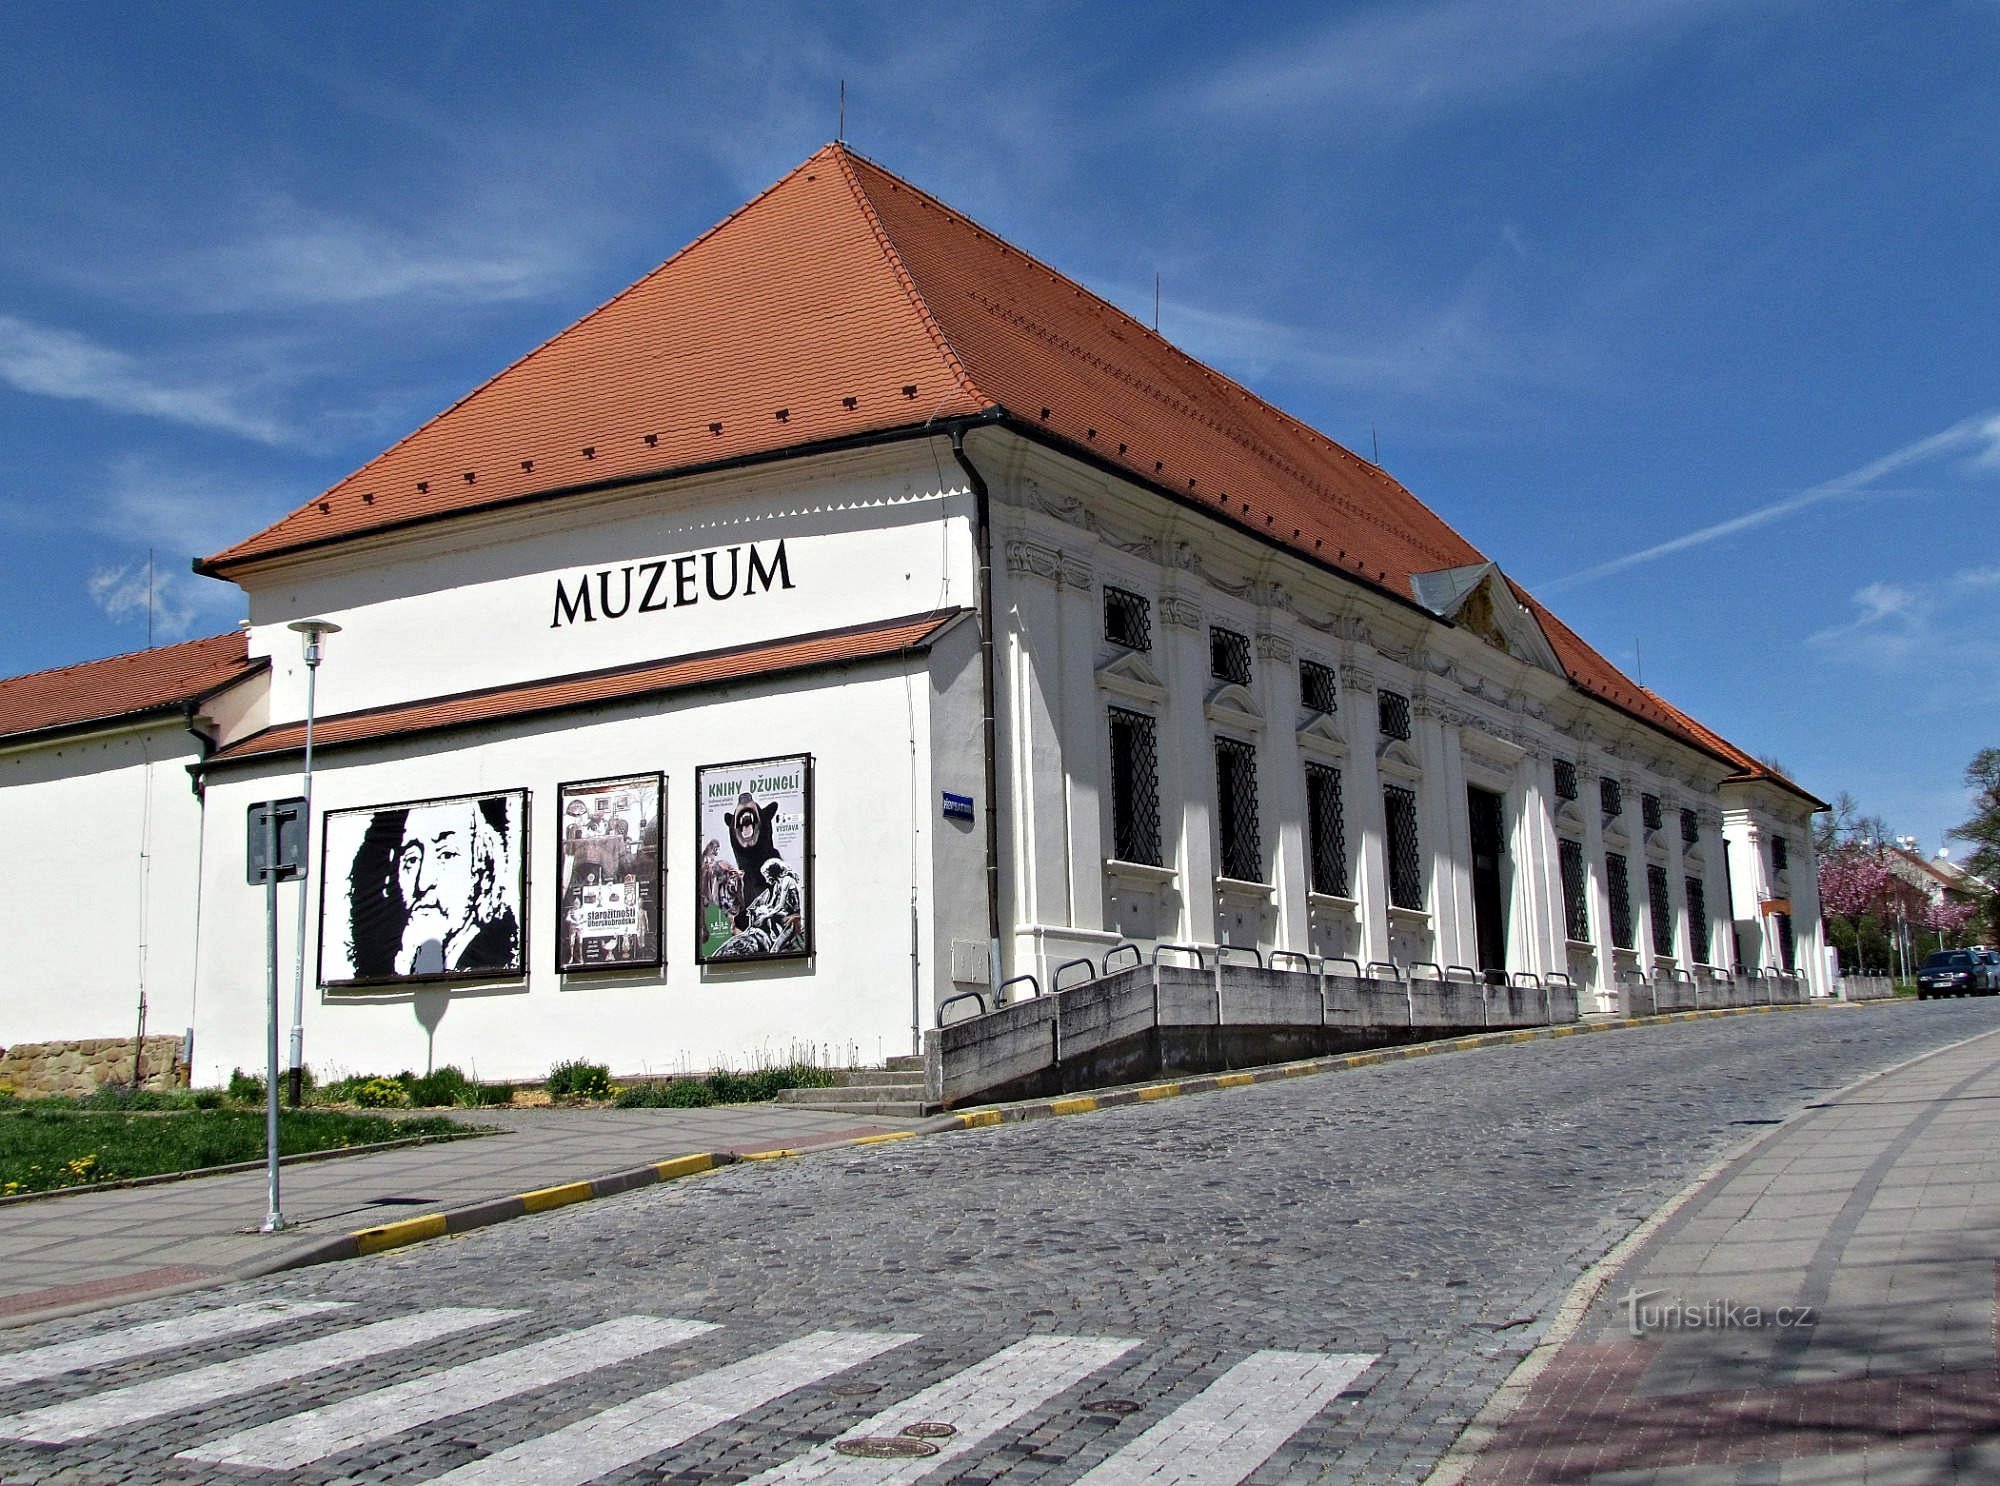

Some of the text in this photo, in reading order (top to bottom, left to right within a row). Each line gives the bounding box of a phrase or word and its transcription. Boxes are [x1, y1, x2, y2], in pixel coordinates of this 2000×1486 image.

[551, 538, 795, 628] MUZEUM
[708, 770, 800, 798] KNIHY DŽUNGLÍ
